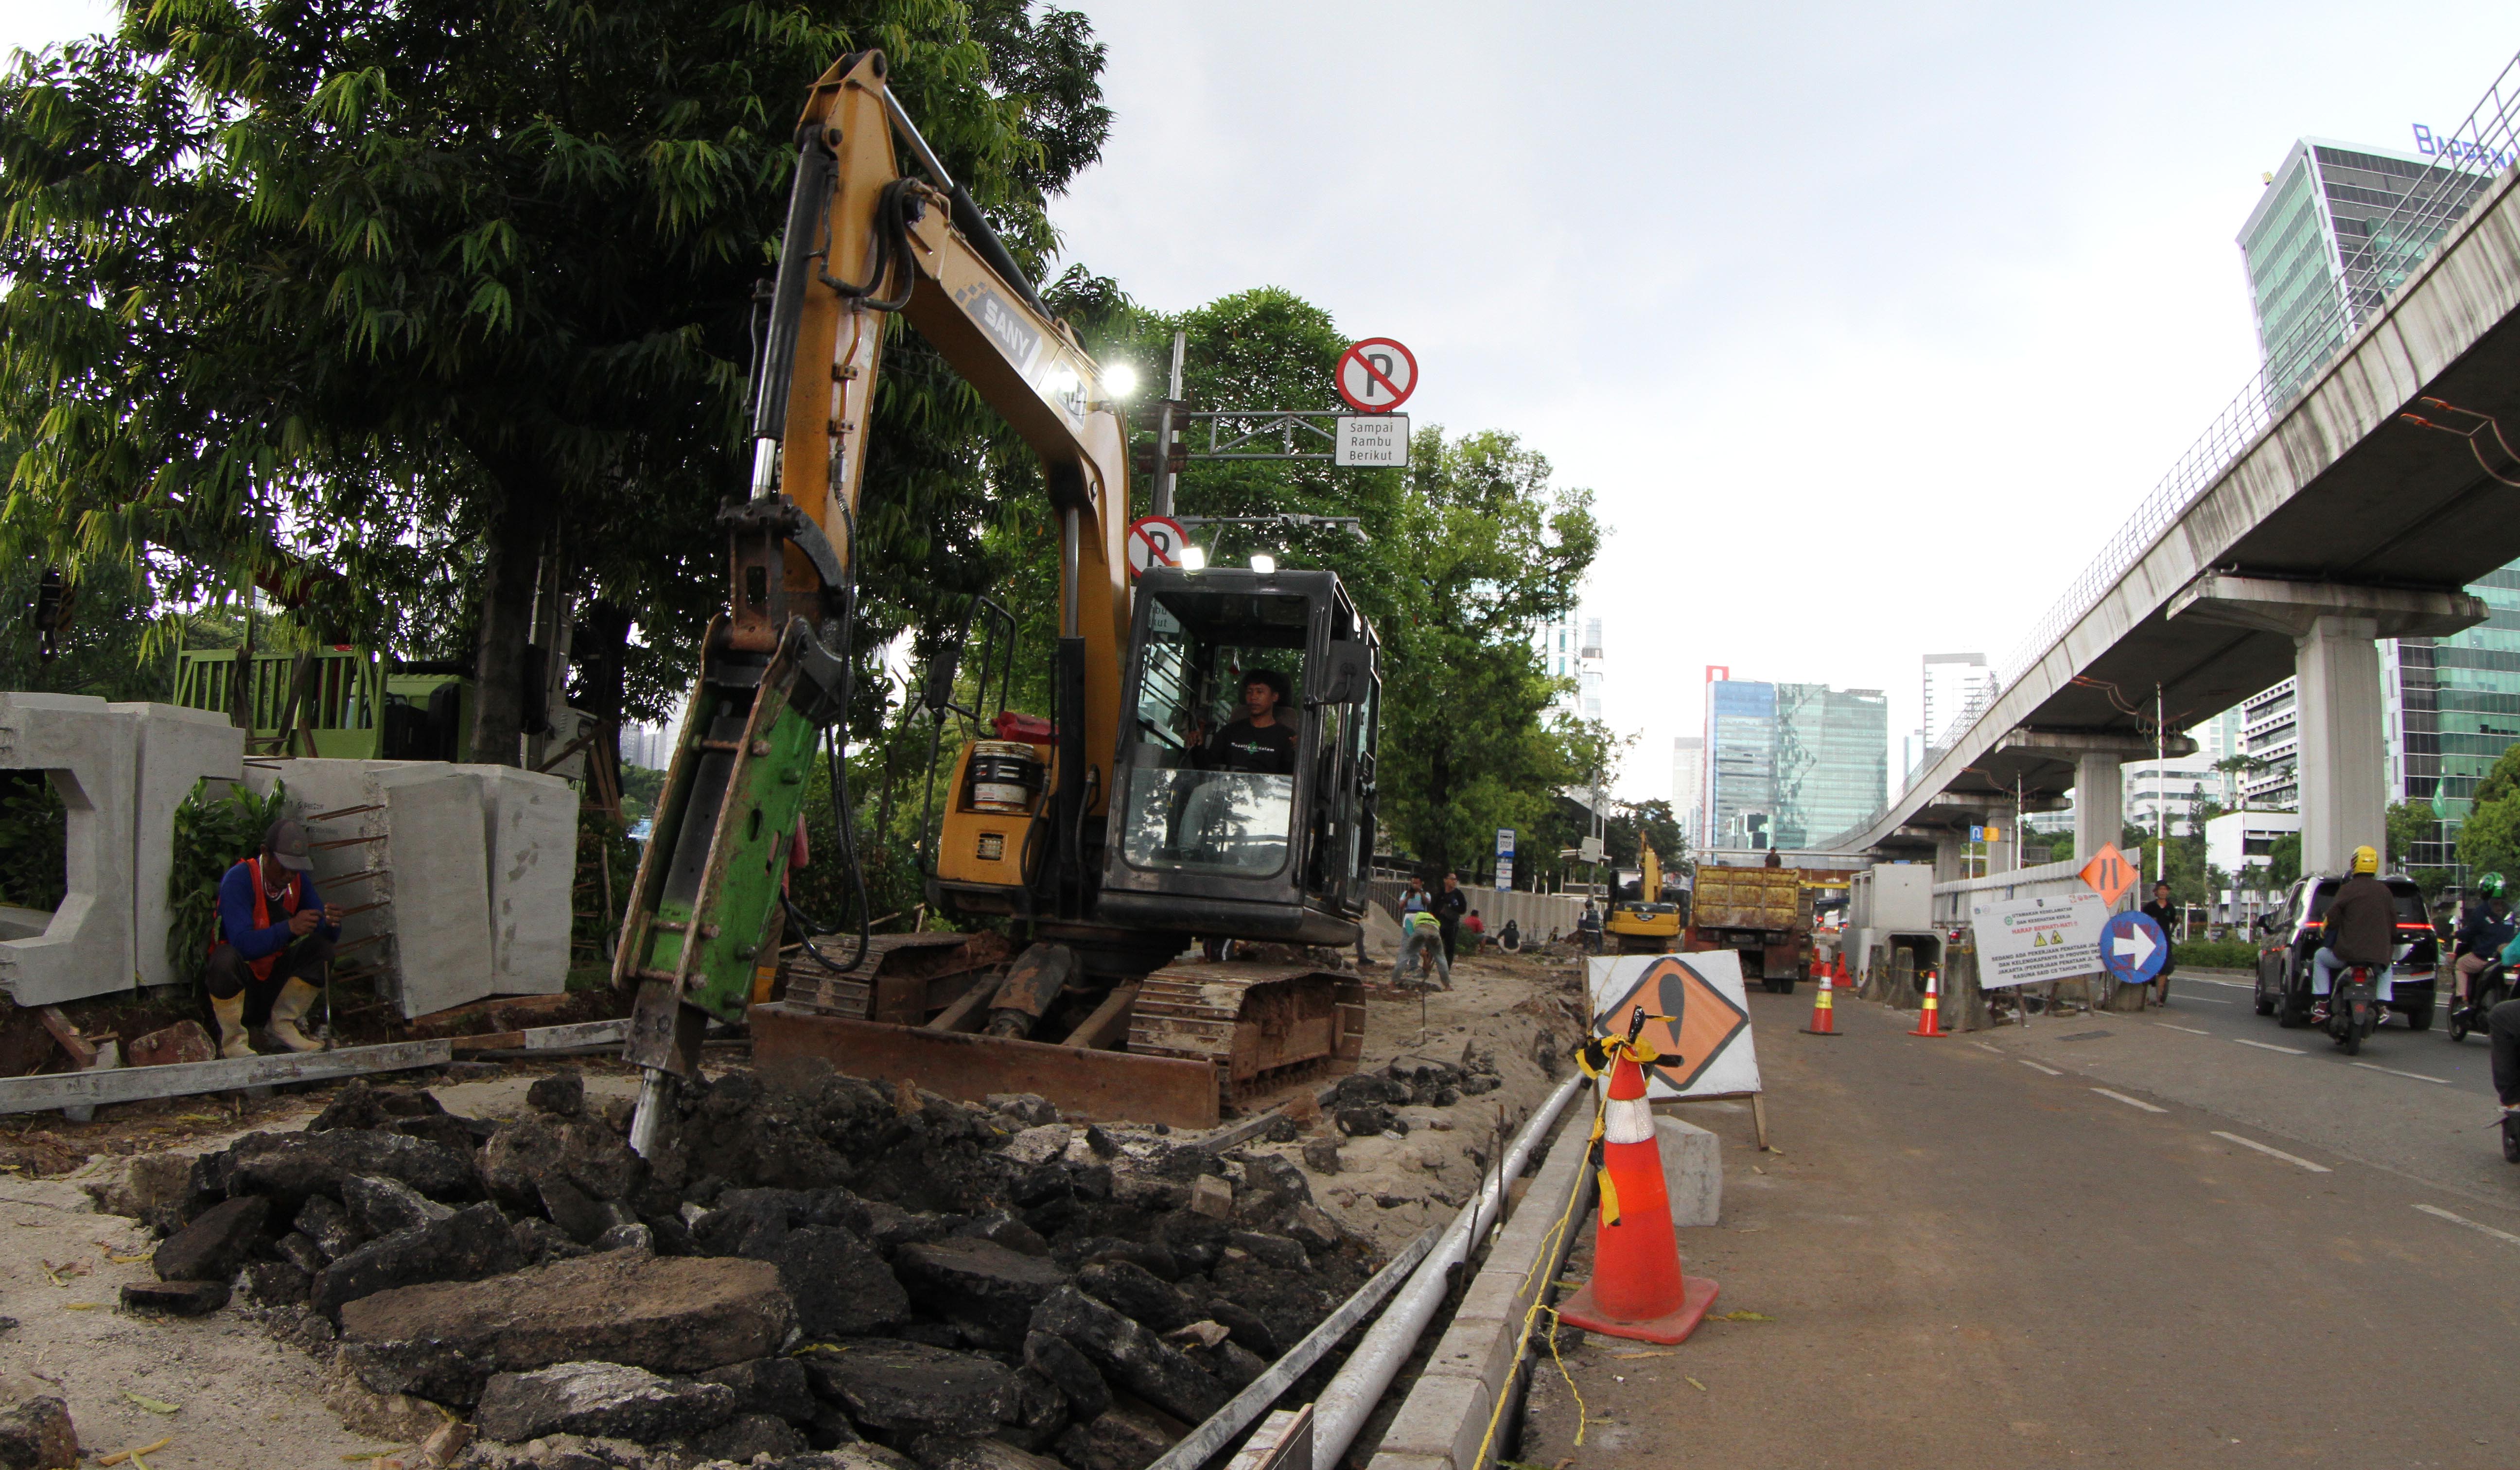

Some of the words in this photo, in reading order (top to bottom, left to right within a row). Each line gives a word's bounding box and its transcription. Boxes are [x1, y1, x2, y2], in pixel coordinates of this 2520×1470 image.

[984, 298, 1030, 358] SANY
[1366, 354, 1393, 397] P
[1350, 422, 1393, 435] Sampai
[1351, 437, 1391, 446] Rambu
[1350, 450, 1392, 460] Berikut
[1147, 531, 1170, 567] P
[2033, 922, 2073, 931] BERHATI-HATI
[2027, 948, 2059, 956] PEKERJAAN
